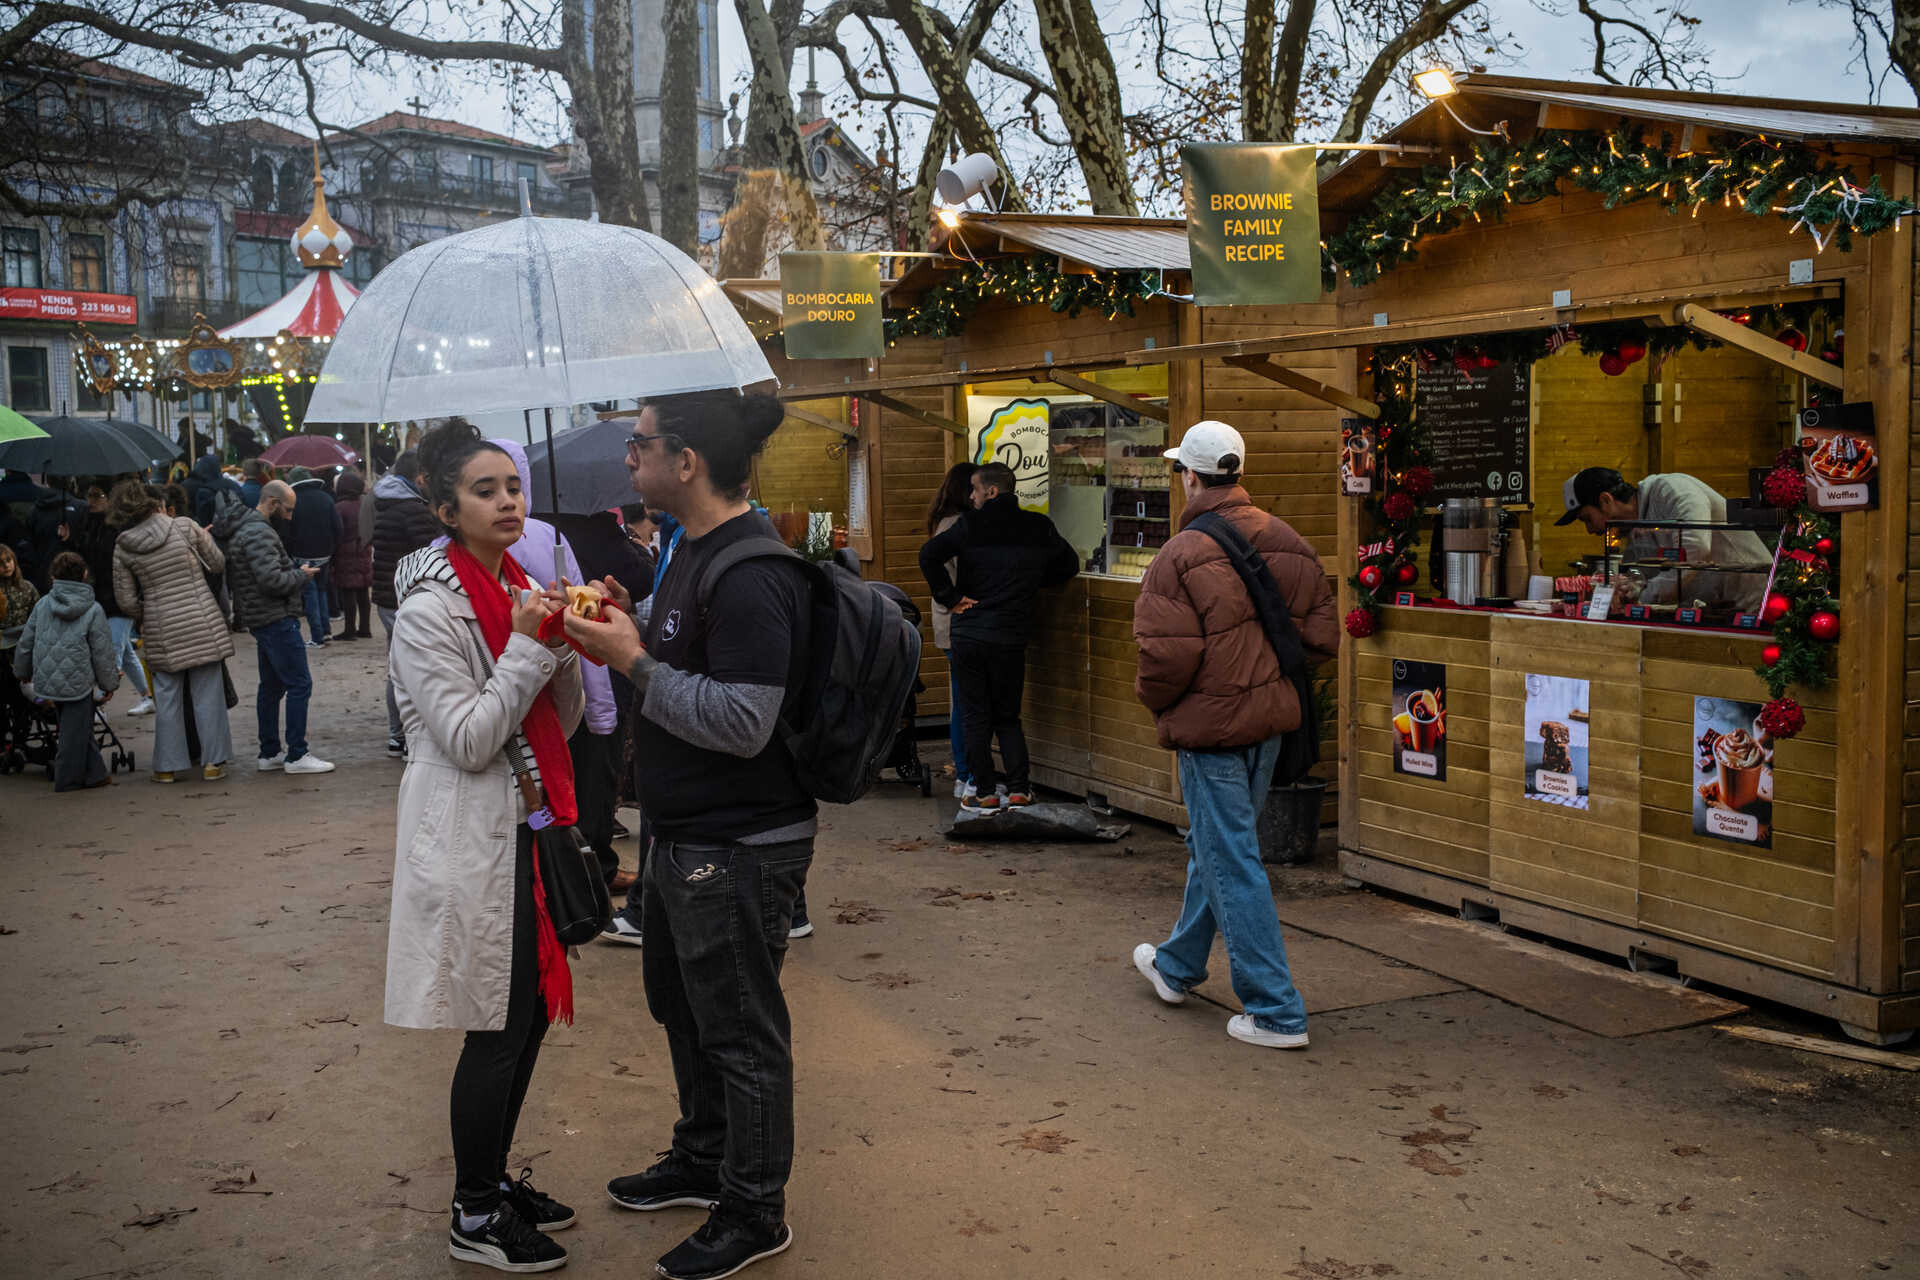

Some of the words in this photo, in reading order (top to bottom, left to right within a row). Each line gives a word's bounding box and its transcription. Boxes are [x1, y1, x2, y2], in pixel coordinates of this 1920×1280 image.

[1210, 193, 1293, 211] BROWNIE
[1224, 218, 1283, 236] FAMILY
[1225, 244, 1285, 262] RECIPE
[40, 295, 73, 305] VENDE
[787, 293, 874, 304] BOMBOCARIA
[41, 304, 77, 316] PRÉDIO
[807, 310, 855, 321] DOURO
[996, 442, 1049, 471] Dou
[1826, 490, 1859, 500] Waffles
[1713, 813, 1748, 827] Chocolate
[1719, 822, 1744, 834] Quente
